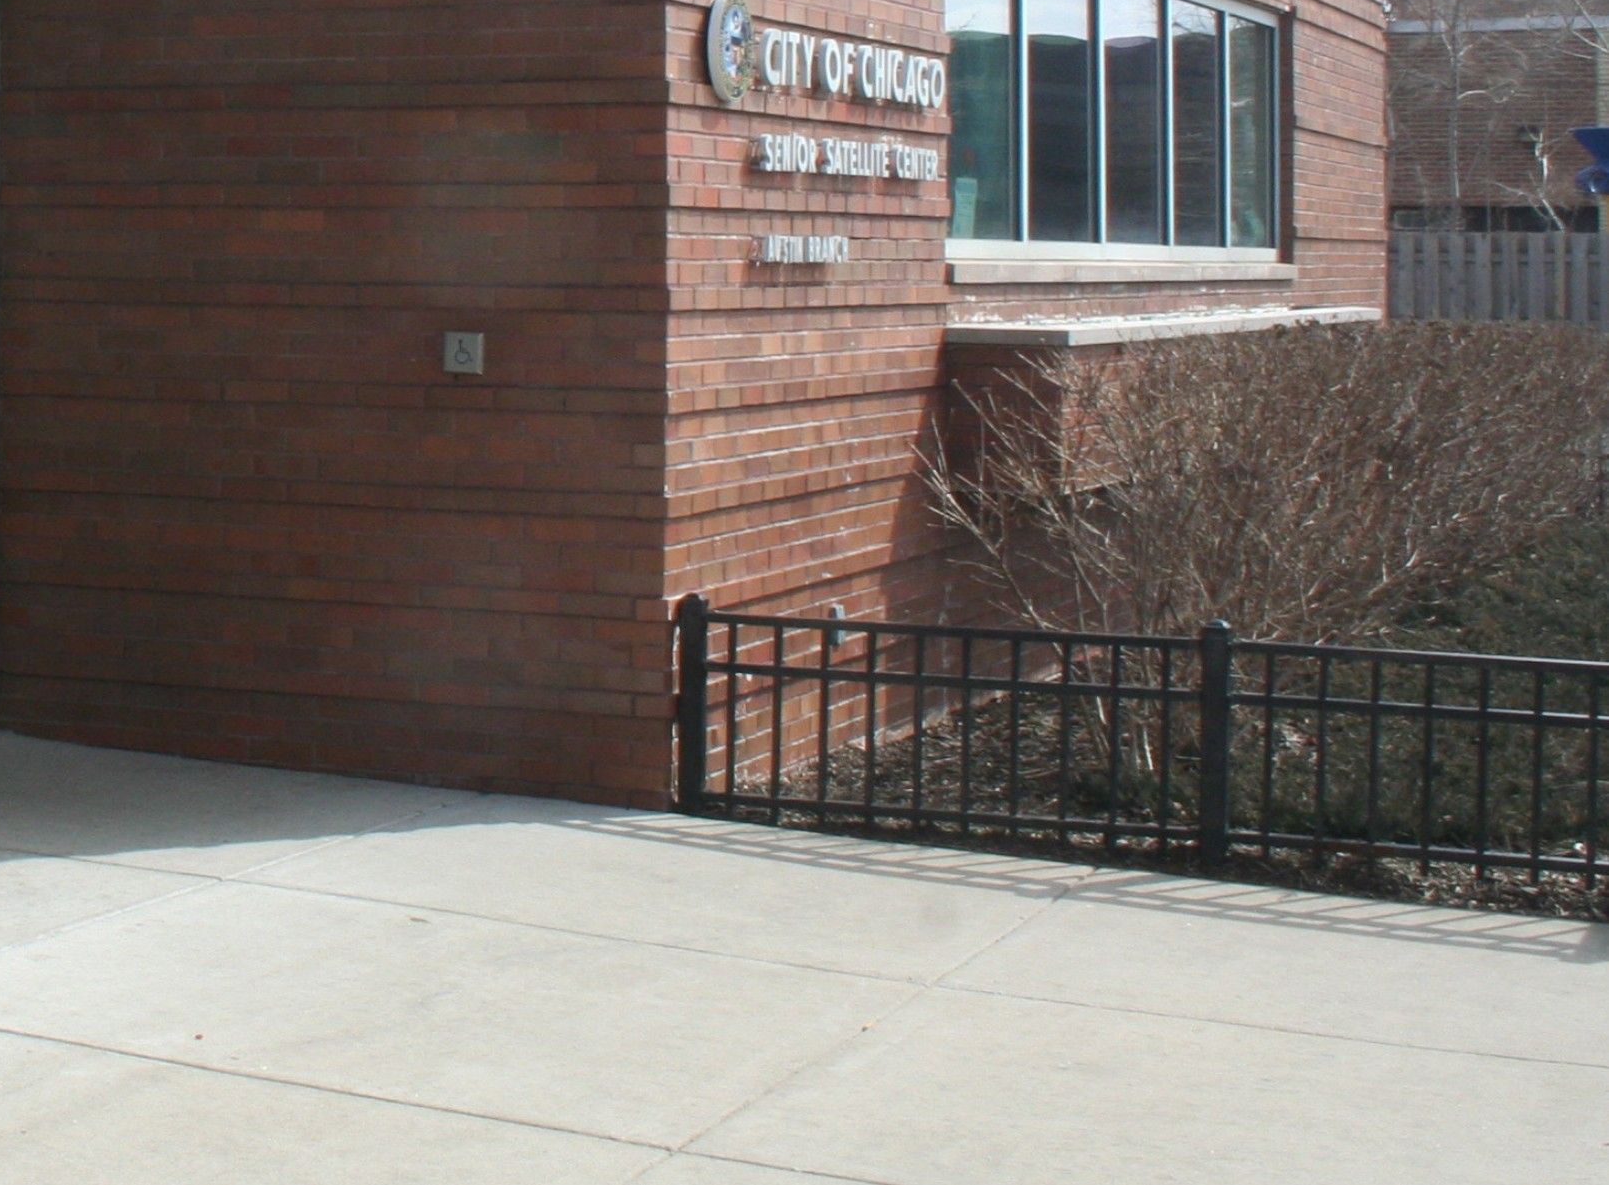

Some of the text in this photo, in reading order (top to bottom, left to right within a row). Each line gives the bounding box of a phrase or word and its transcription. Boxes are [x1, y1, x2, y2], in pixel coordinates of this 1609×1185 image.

[761, 28, 945, 109] CITY OF CHICAGO
[761, 133, 939, 181] SENIOR SATELLITE CENTER
